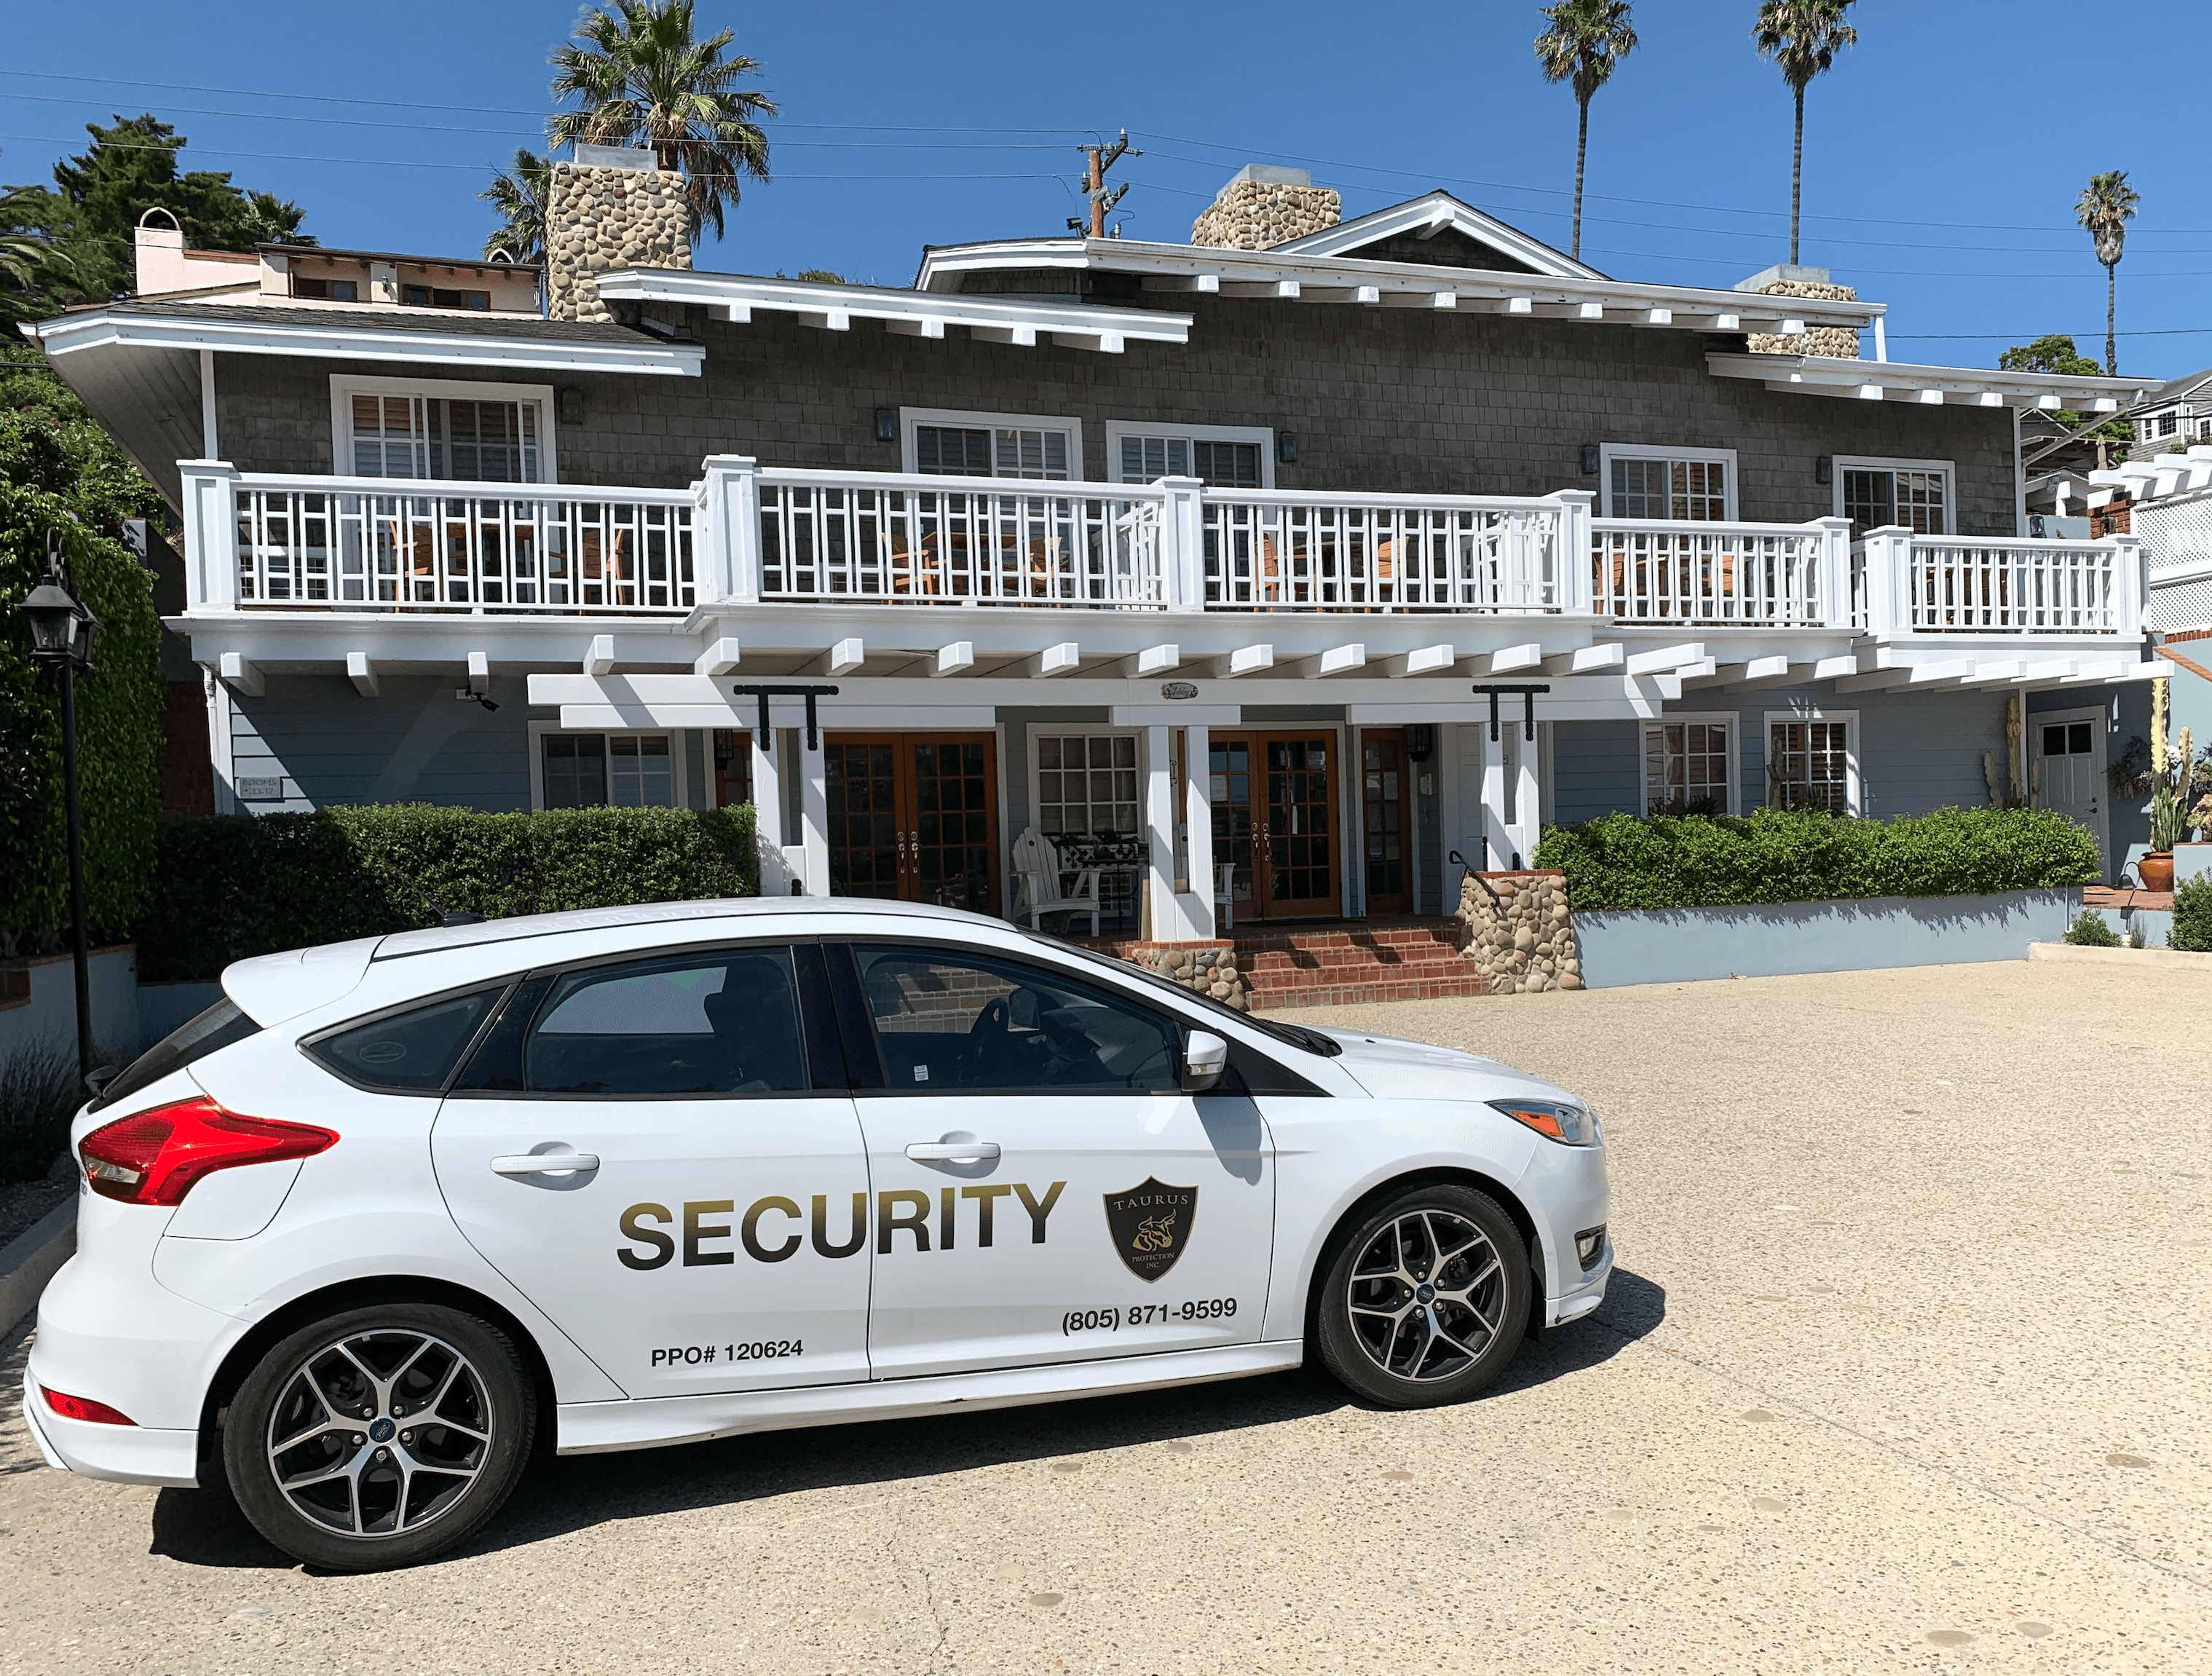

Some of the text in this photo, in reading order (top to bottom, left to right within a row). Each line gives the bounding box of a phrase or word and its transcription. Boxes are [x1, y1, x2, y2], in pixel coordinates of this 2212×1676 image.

[1113, 1195, 1188, 1211] TAURUS
[617, 1180, 1067, 1271] SECURITY
[1131, 1252, 1175, 1262] PROTECTION
[1062, 1297, 1237, 1337] (805) 871-9599
[652, 1339, 804, 1367] PPO# 120624
